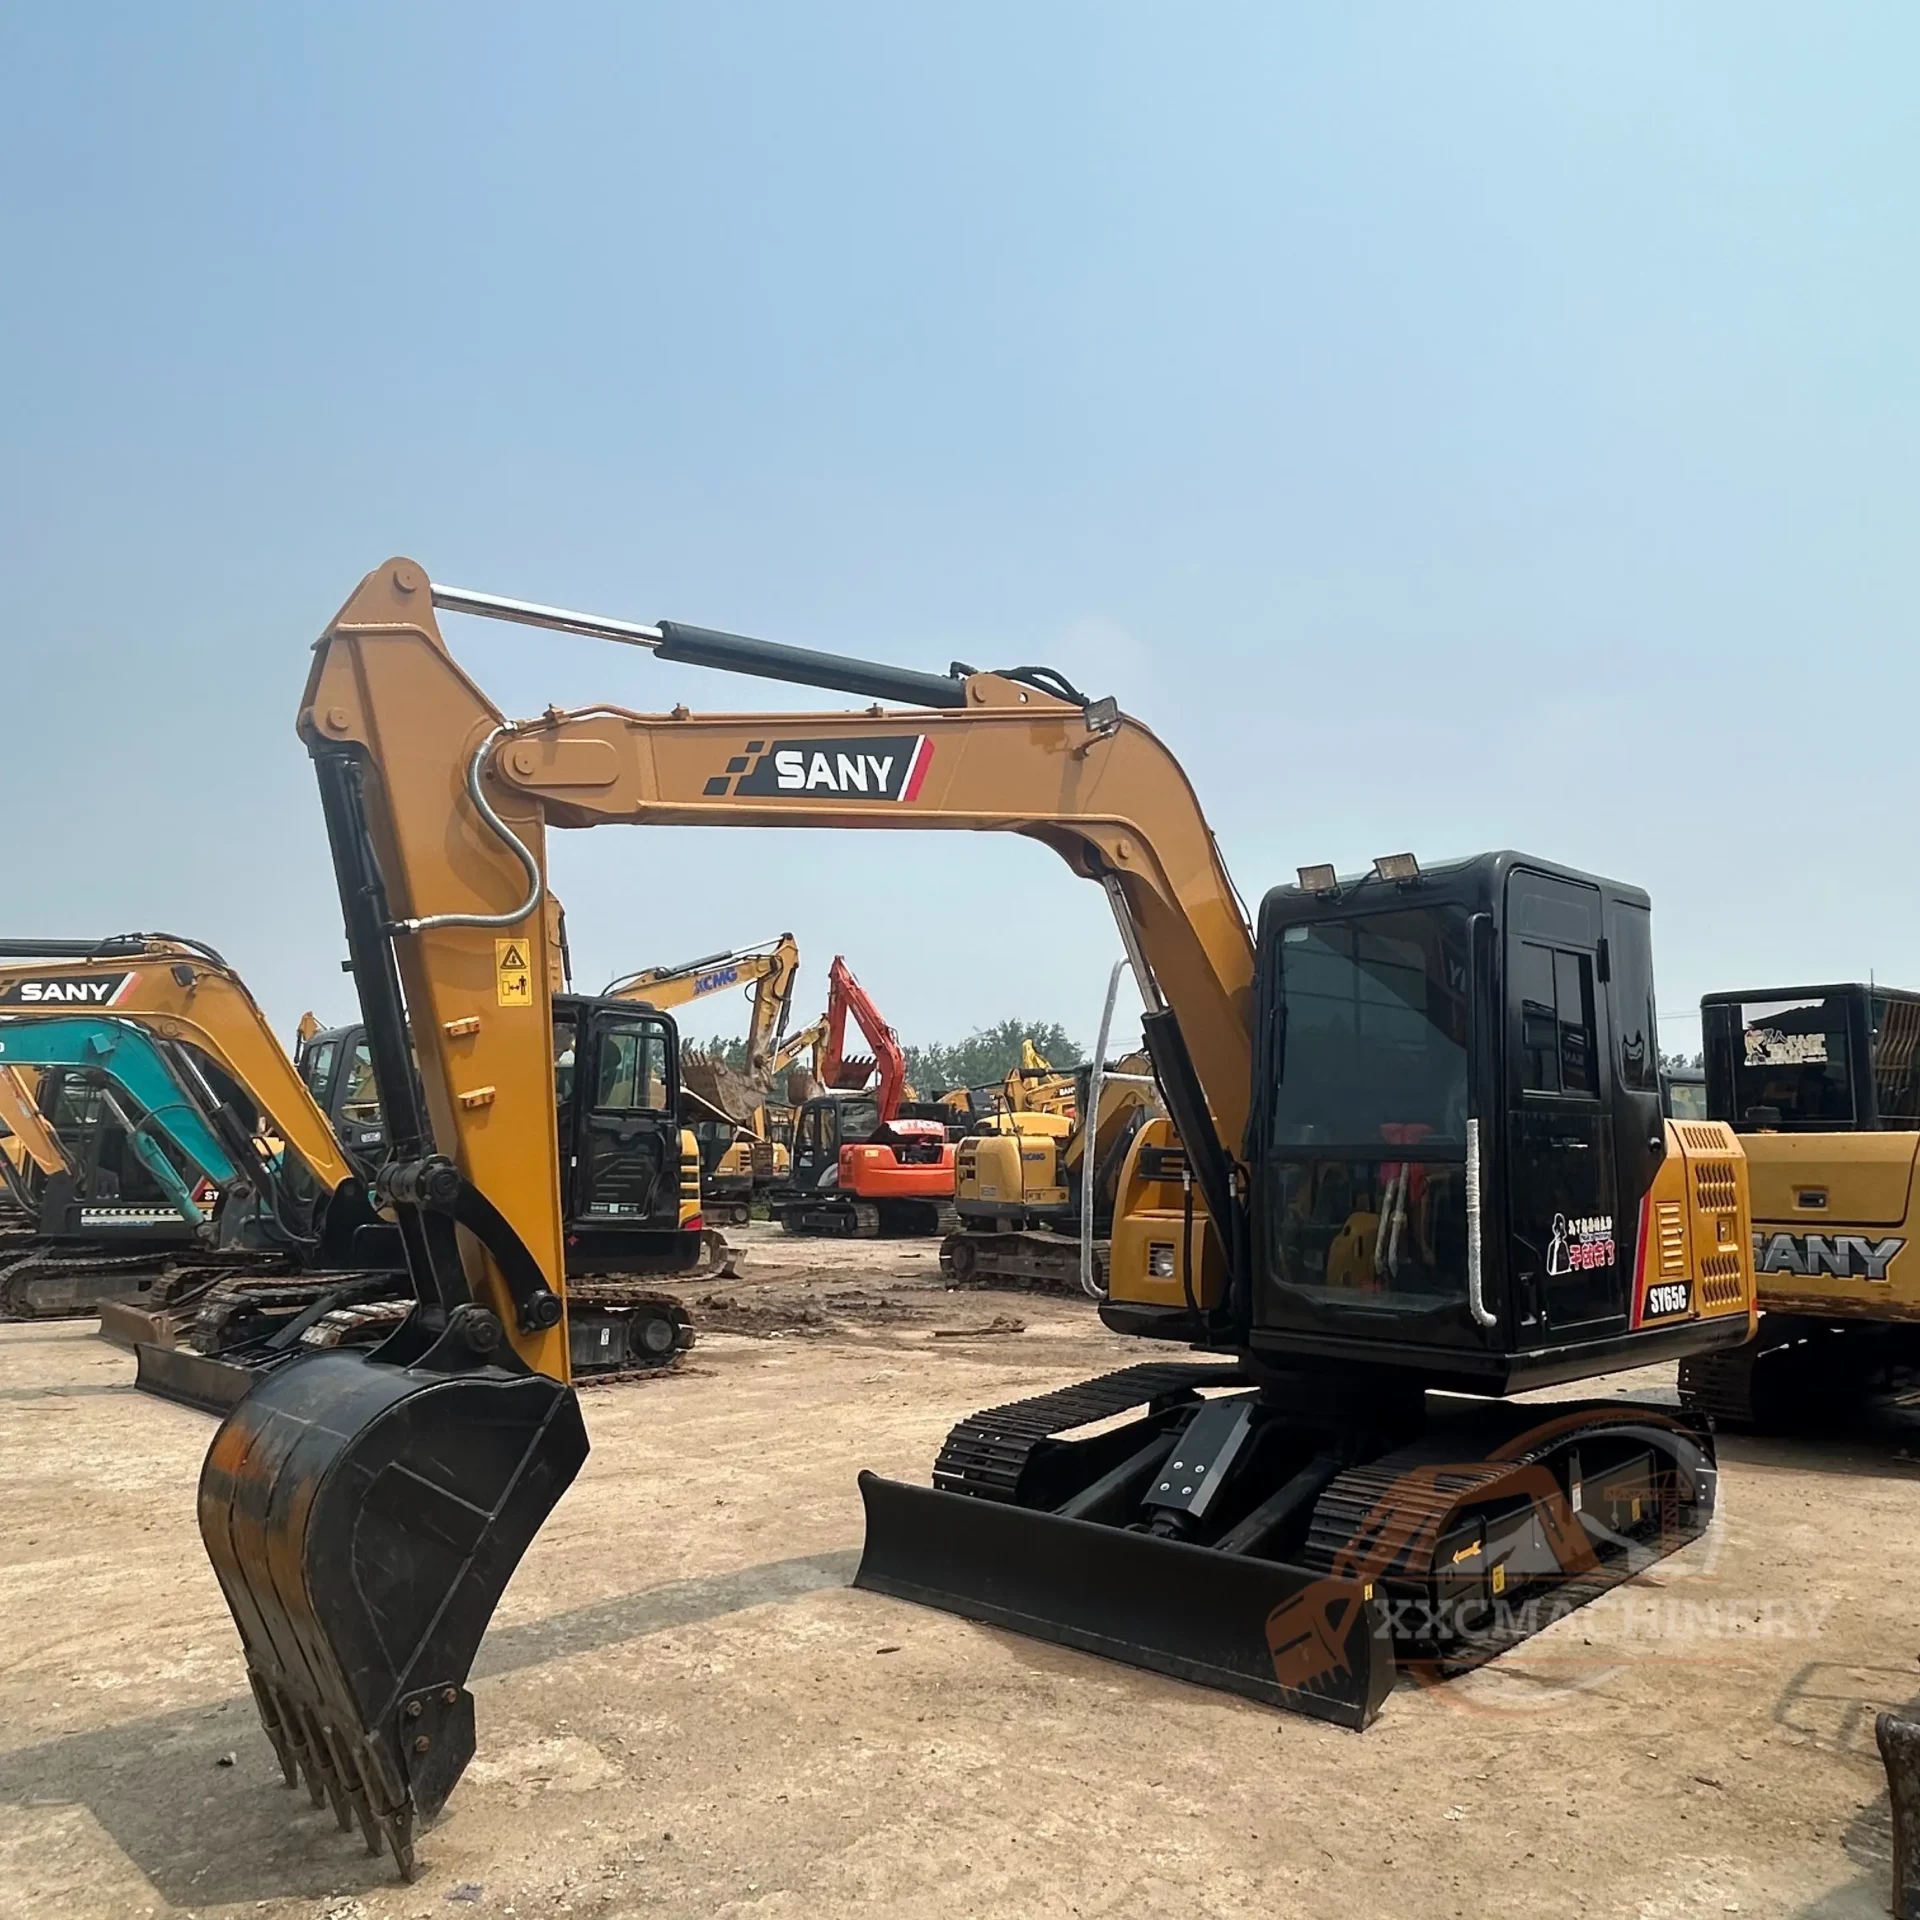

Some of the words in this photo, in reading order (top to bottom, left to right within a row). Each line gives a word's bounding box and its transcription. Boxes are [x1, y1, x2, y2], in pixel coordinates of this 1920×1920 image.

[775, 750, 894, 792] SANY
[21, 983, 109, 1001] SANY
[695, 967, 738, 994] XCMG
[1650, 1284, 1687, 1314] SY65C
